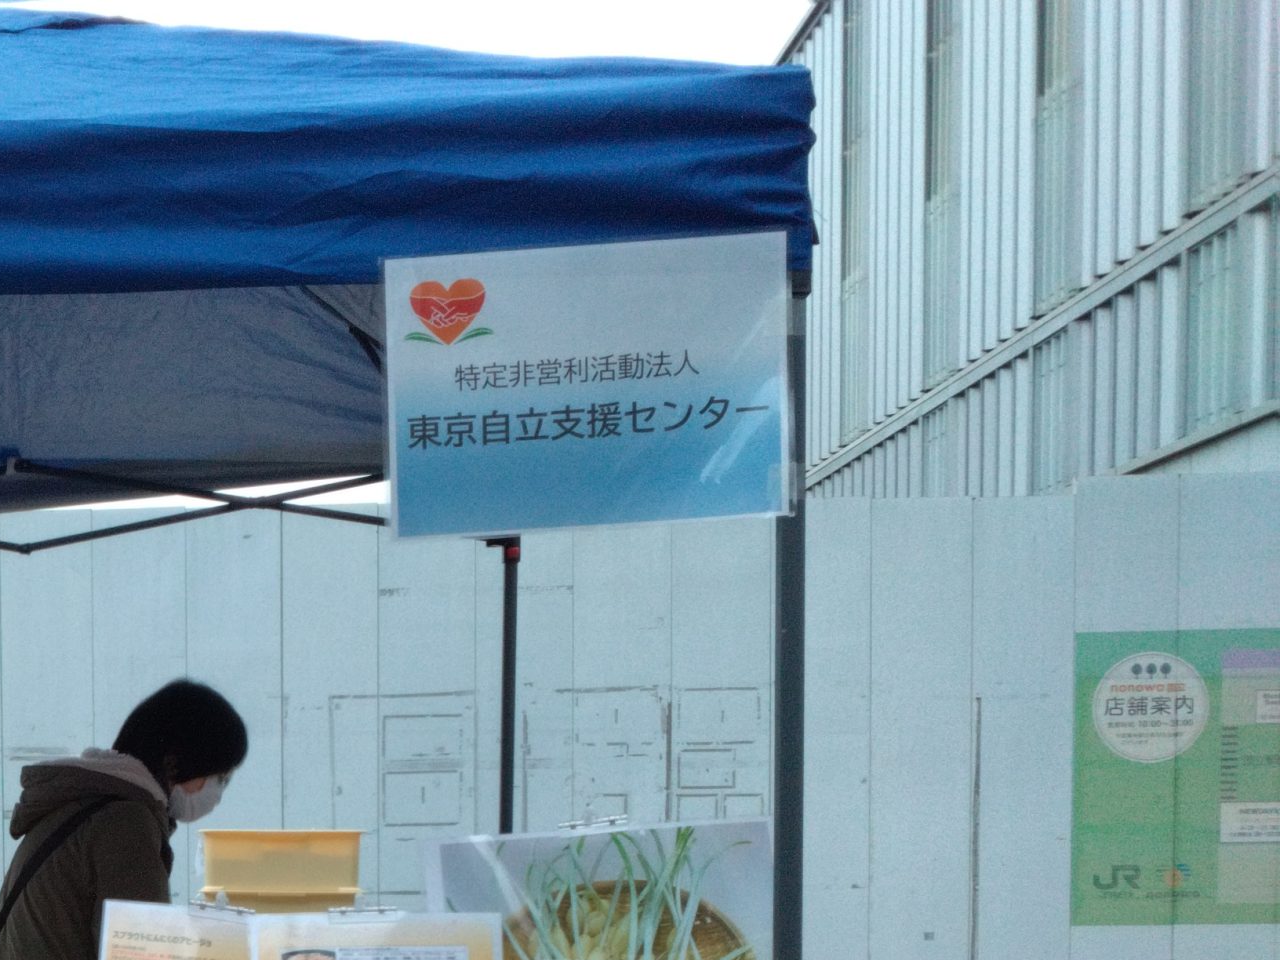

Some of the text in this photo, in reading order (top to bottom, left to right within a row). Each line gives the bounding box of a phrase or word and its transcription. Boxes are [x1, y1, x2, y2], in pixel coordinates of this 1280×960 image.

[454, 349, 700, 392] 特定非営利活動法人
[407, 394, 770, 450] 東京自立支援センター
[1104, 695, 1195, 716] 店舗案内
[1093, 866, 1141, 890] JR
